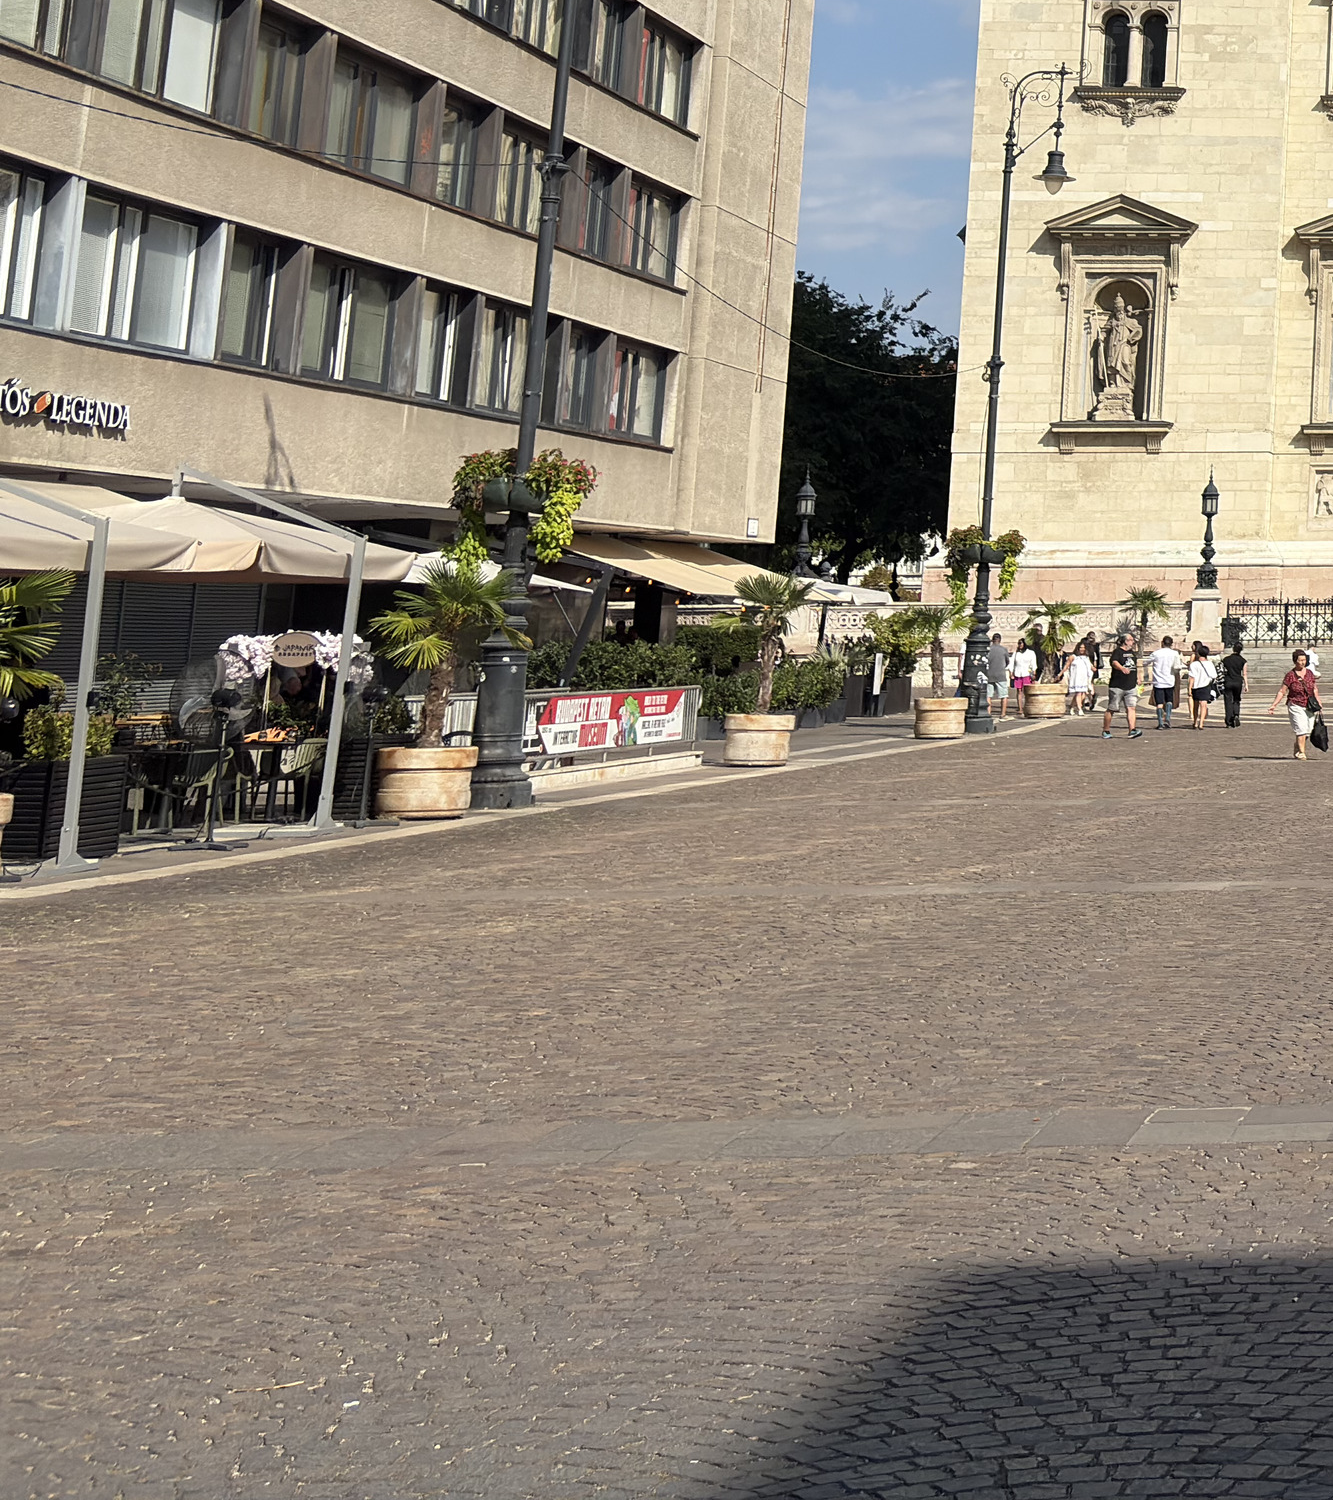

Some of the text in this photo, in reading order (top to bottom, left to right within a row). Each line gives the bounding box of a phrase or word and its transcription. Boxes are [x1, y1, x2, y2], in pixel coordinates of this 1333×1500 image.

[50, 393, 132, 430] LEGENDA
[555, 696, 612, 724] BUDAPEST RETRO
